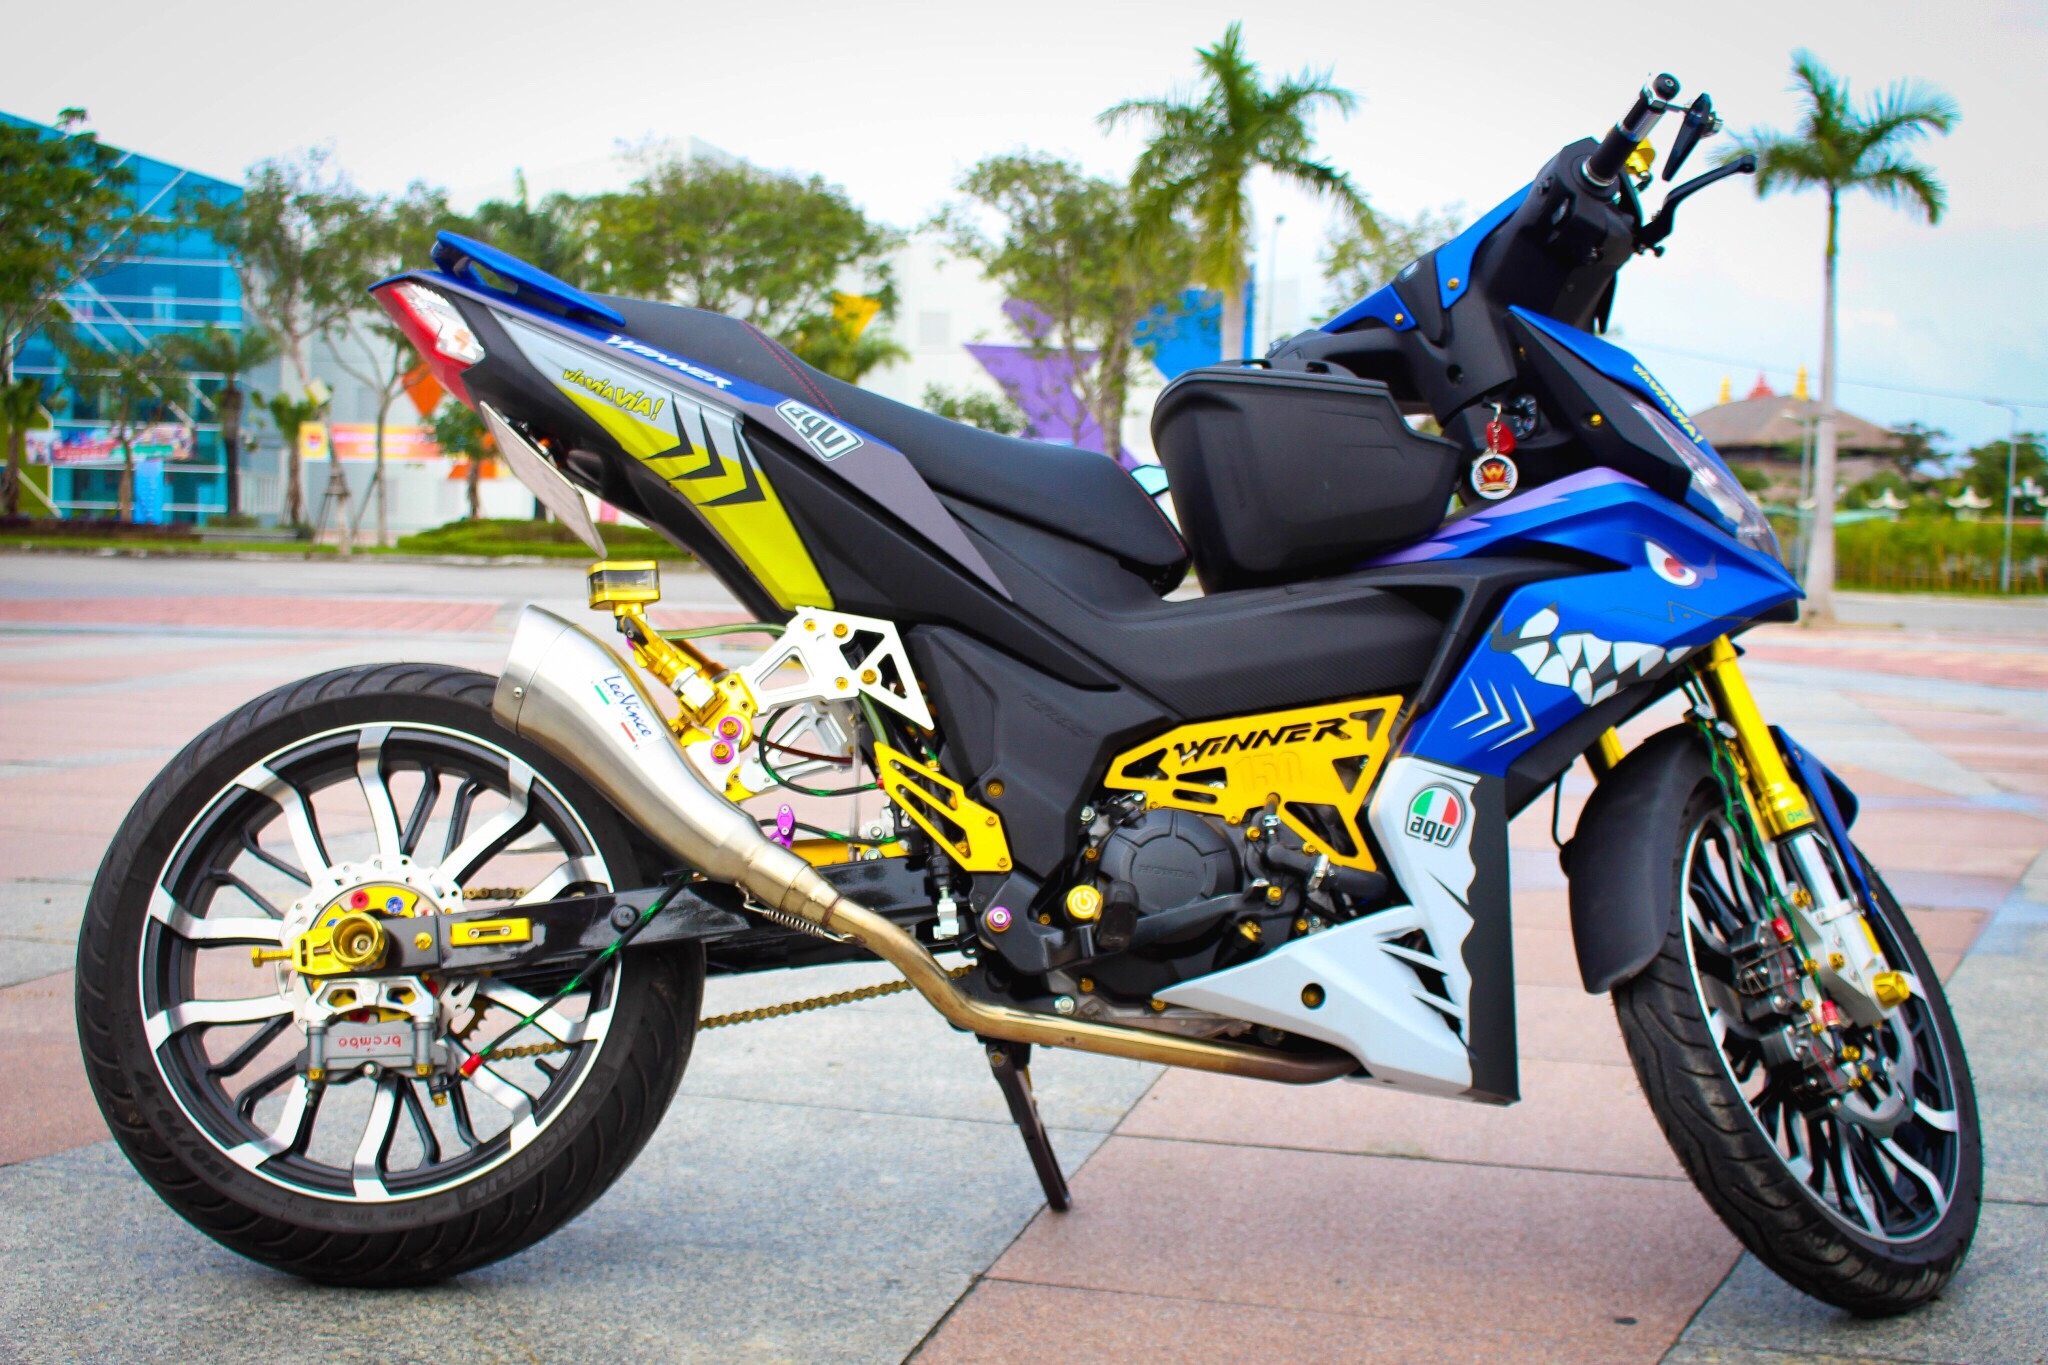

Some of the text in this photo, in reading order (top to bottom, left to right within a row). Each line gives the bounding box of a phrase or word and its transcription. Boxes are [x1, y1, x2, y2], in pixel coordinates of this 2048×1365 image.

[786, 406, 847, 450] agv
[603, 675, 652, 736] LeoVince
[1173, 717, 1352, 766] WINNER
[1410, 815, 1453, 842] agv
[338, 1034, 402, 1049] brembo
[465, 1101, 588, 1205] MICHELIN
